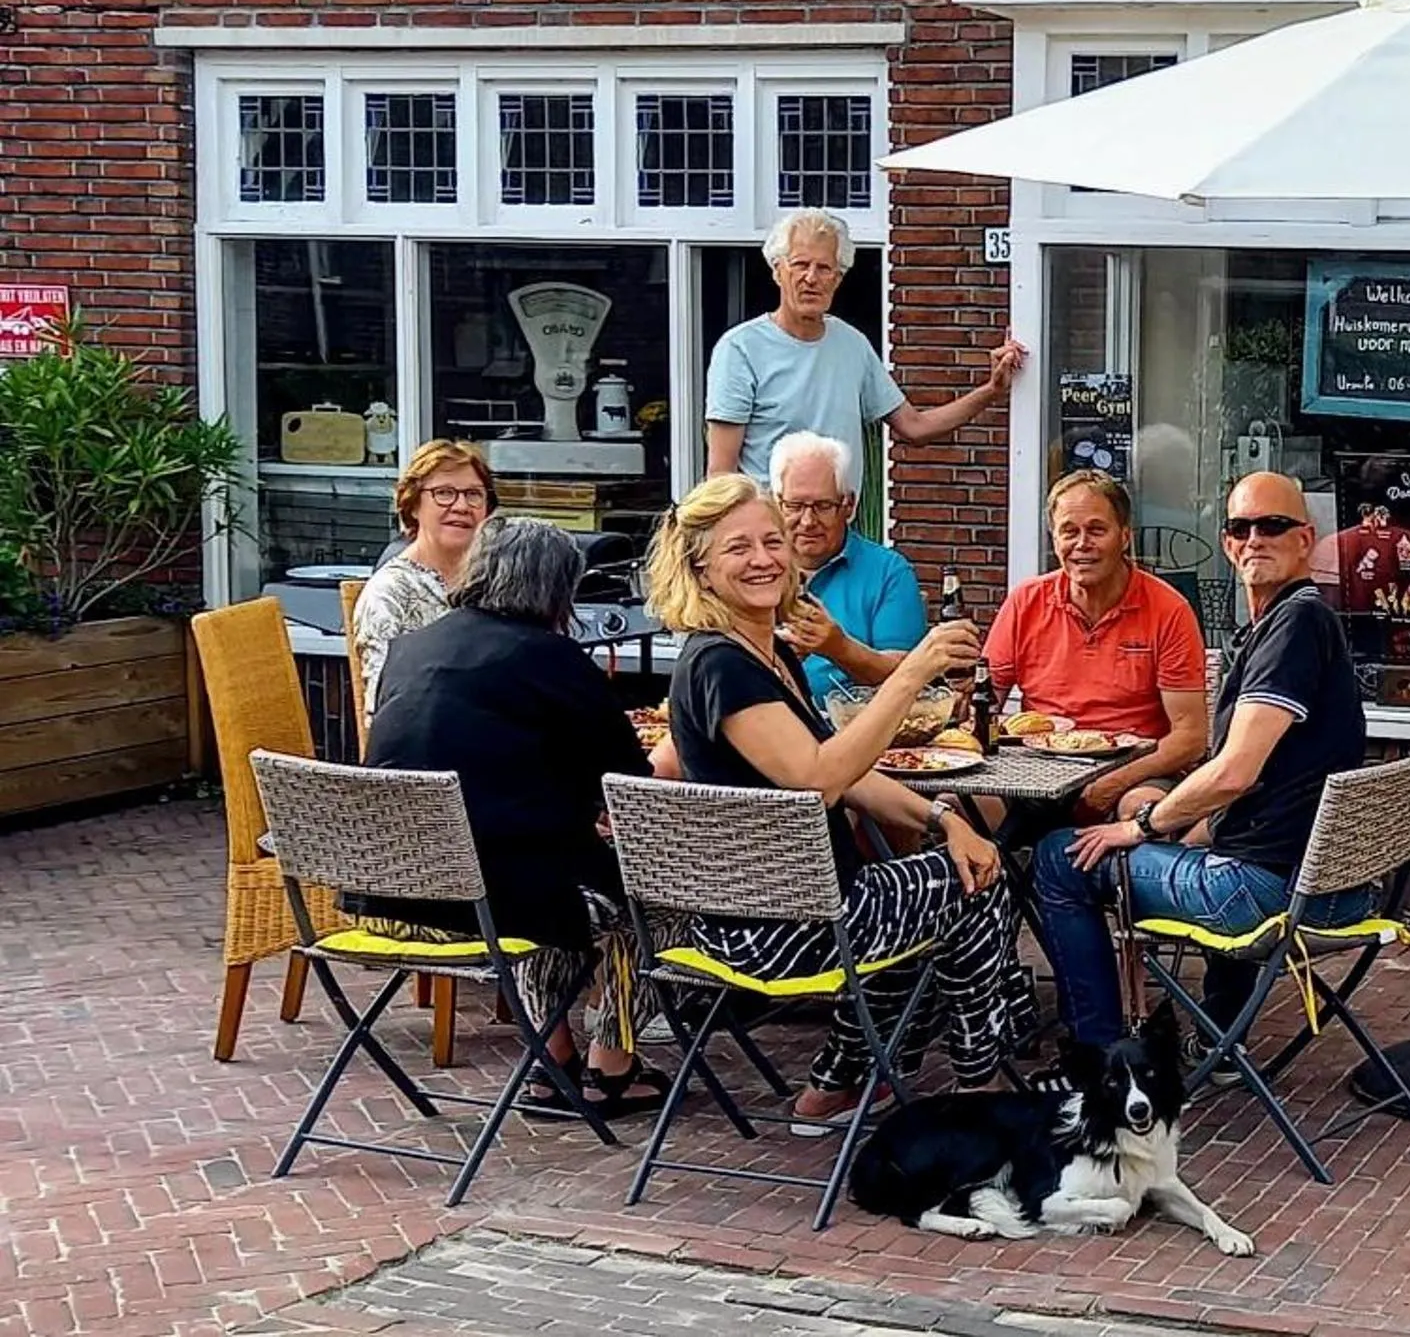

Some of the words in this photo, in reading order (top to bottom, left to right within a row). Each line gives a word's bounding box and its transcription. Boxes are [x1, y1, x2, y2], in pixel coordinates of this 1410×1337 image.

[989, 231, 1011, 259] 35
[15, 339, 27, 353] EN
[1061, 387, 1099, 403] Peer
